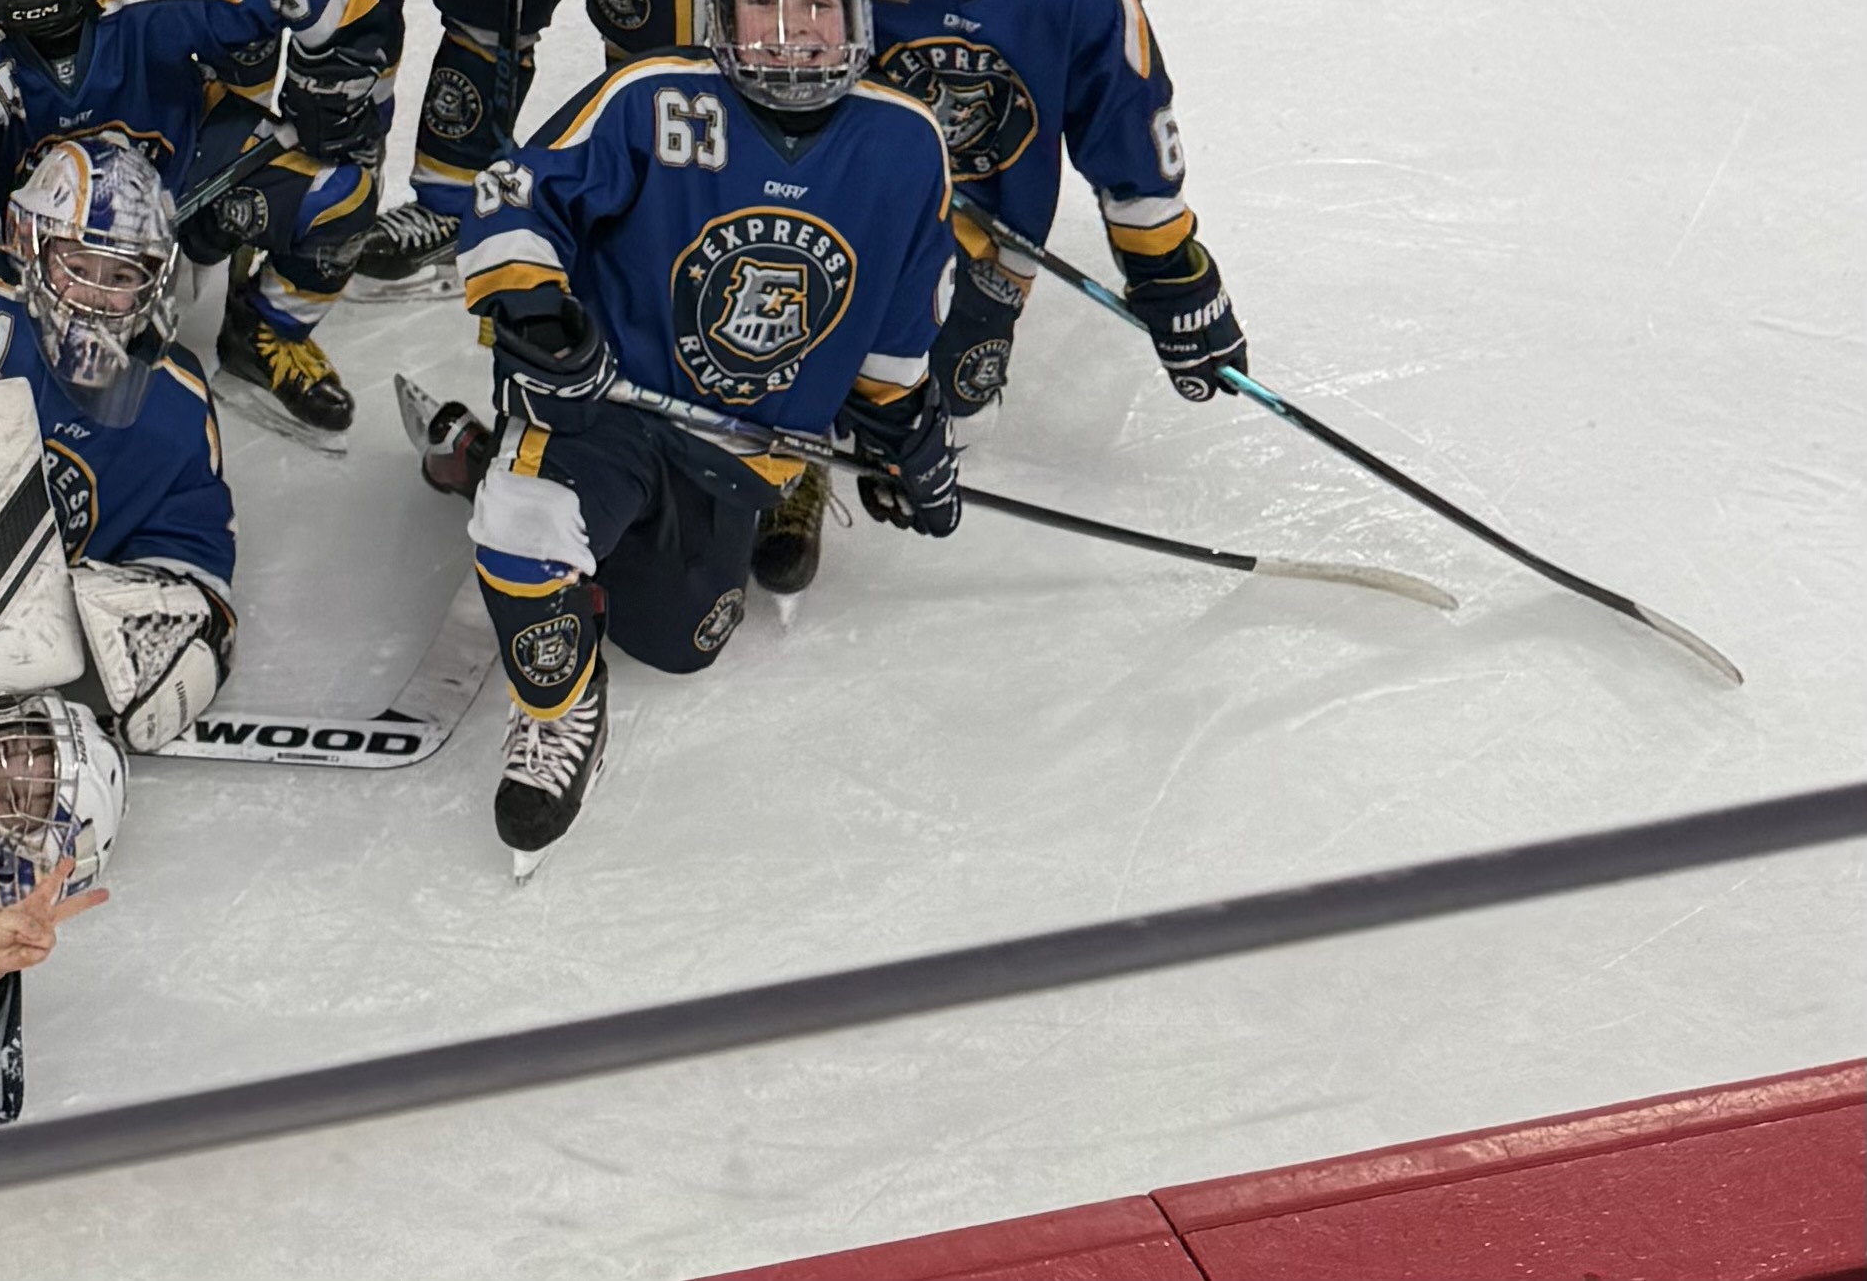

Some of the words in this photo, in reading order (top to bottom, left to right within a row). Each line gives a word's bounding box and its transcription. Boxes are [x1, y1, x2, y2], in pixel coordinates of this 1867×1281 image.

[904, 44, 1007, 74] EPRE
[653, 86, 728, 172] 63
[703, 218, 848, 275] EXPRESS
[43, 451, 89, 530] RESS
[192, 720, 424, 758] WOOD
